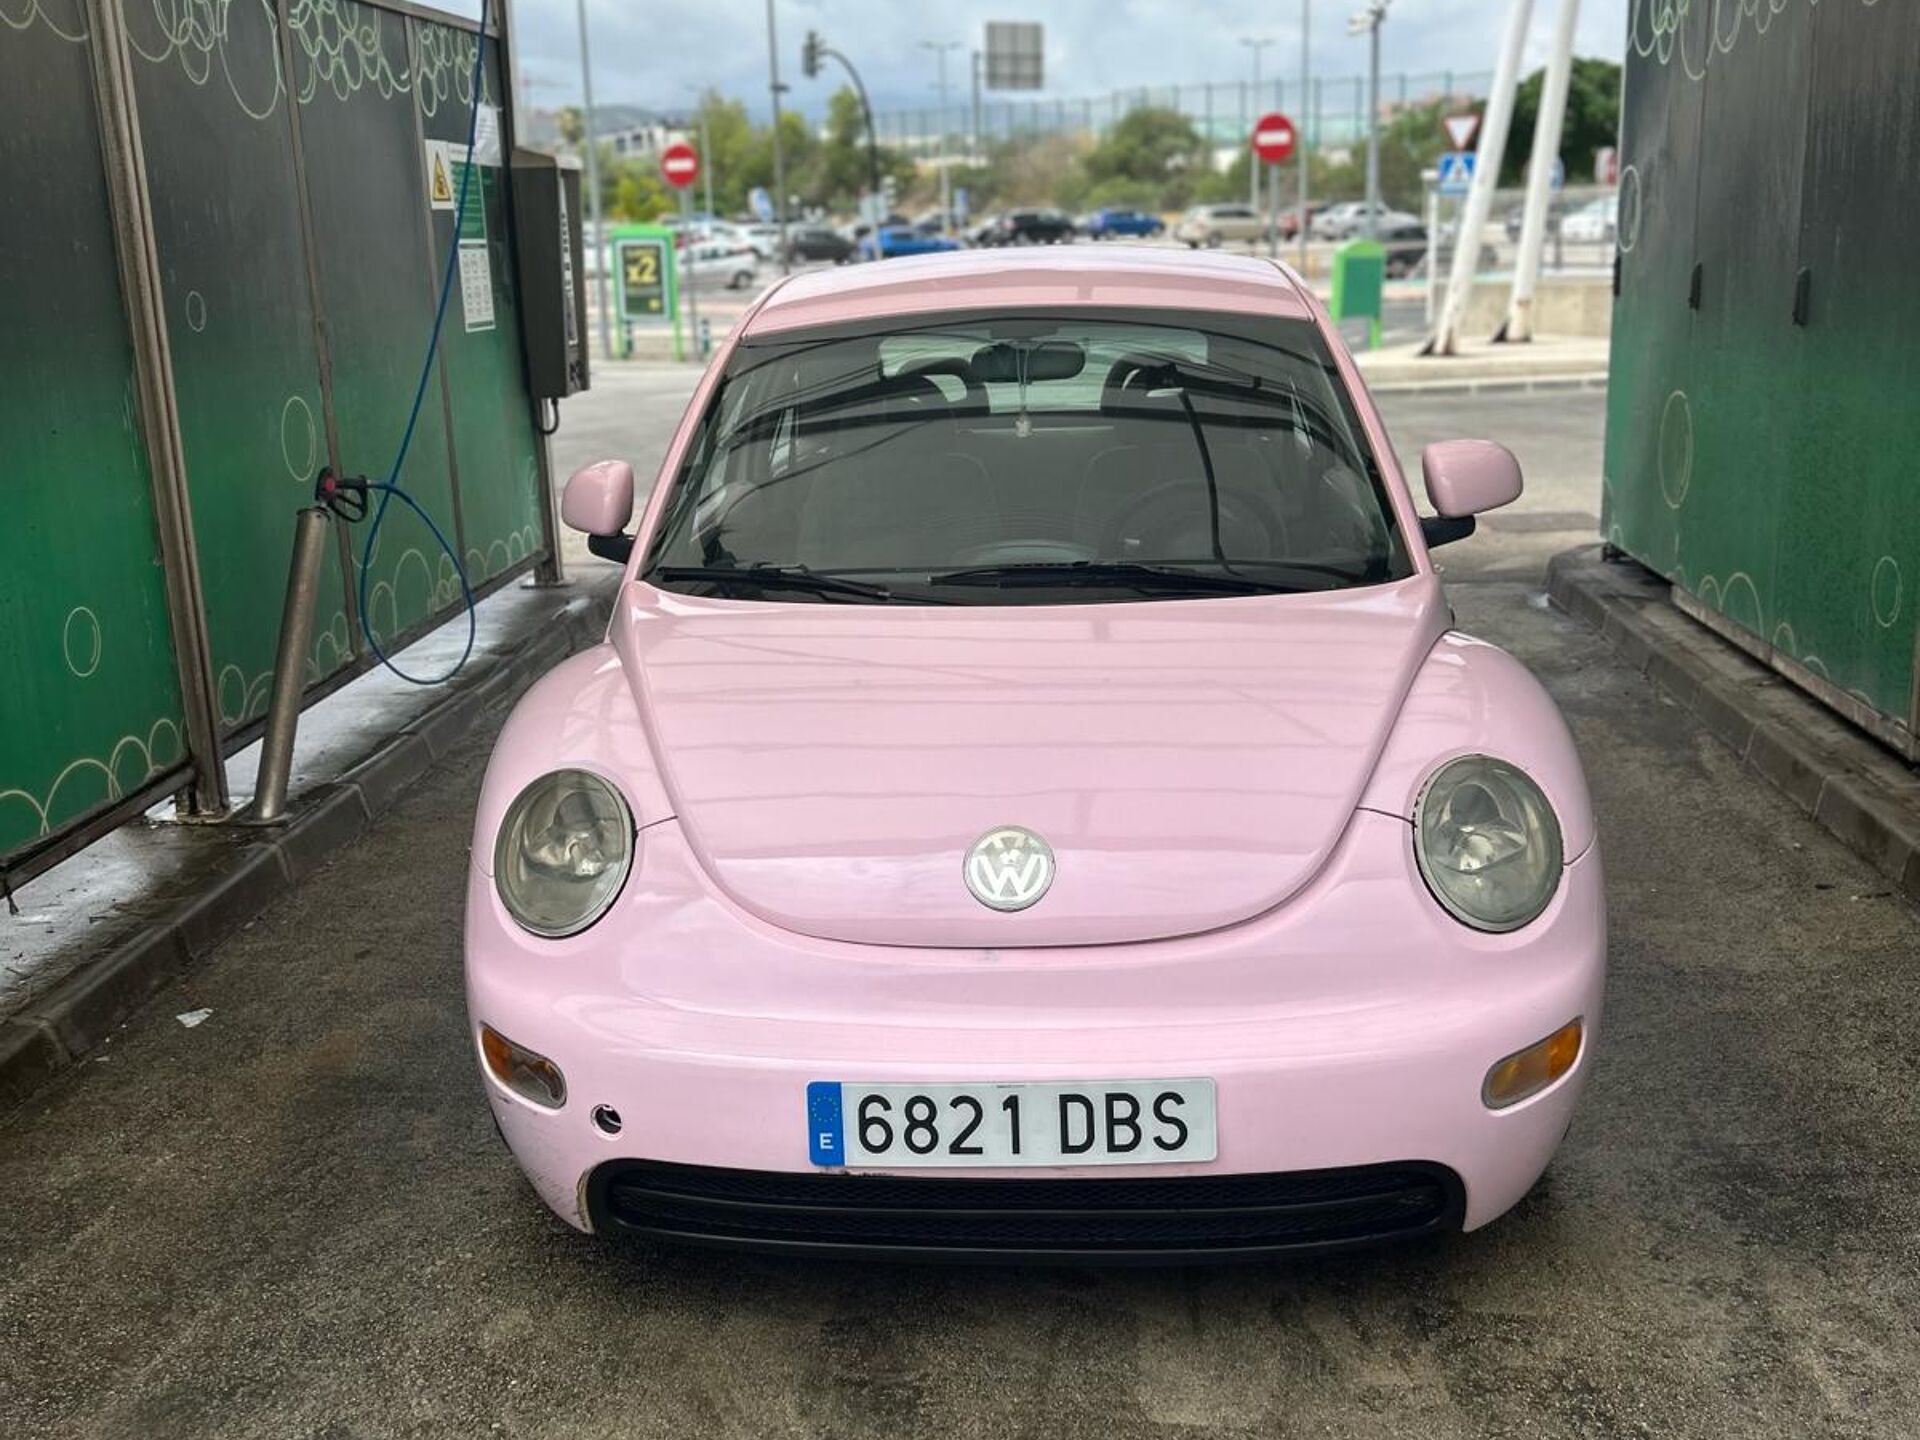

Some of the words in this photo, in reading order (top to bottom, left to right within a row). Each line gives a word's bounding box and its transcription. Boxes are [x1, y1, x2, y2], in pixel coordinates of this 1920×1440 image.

[819, 1132, 833, 1150] E
[857, 1093, 1021, 1155] 6821
[1058, 1091, 1189, 1155] DBS
